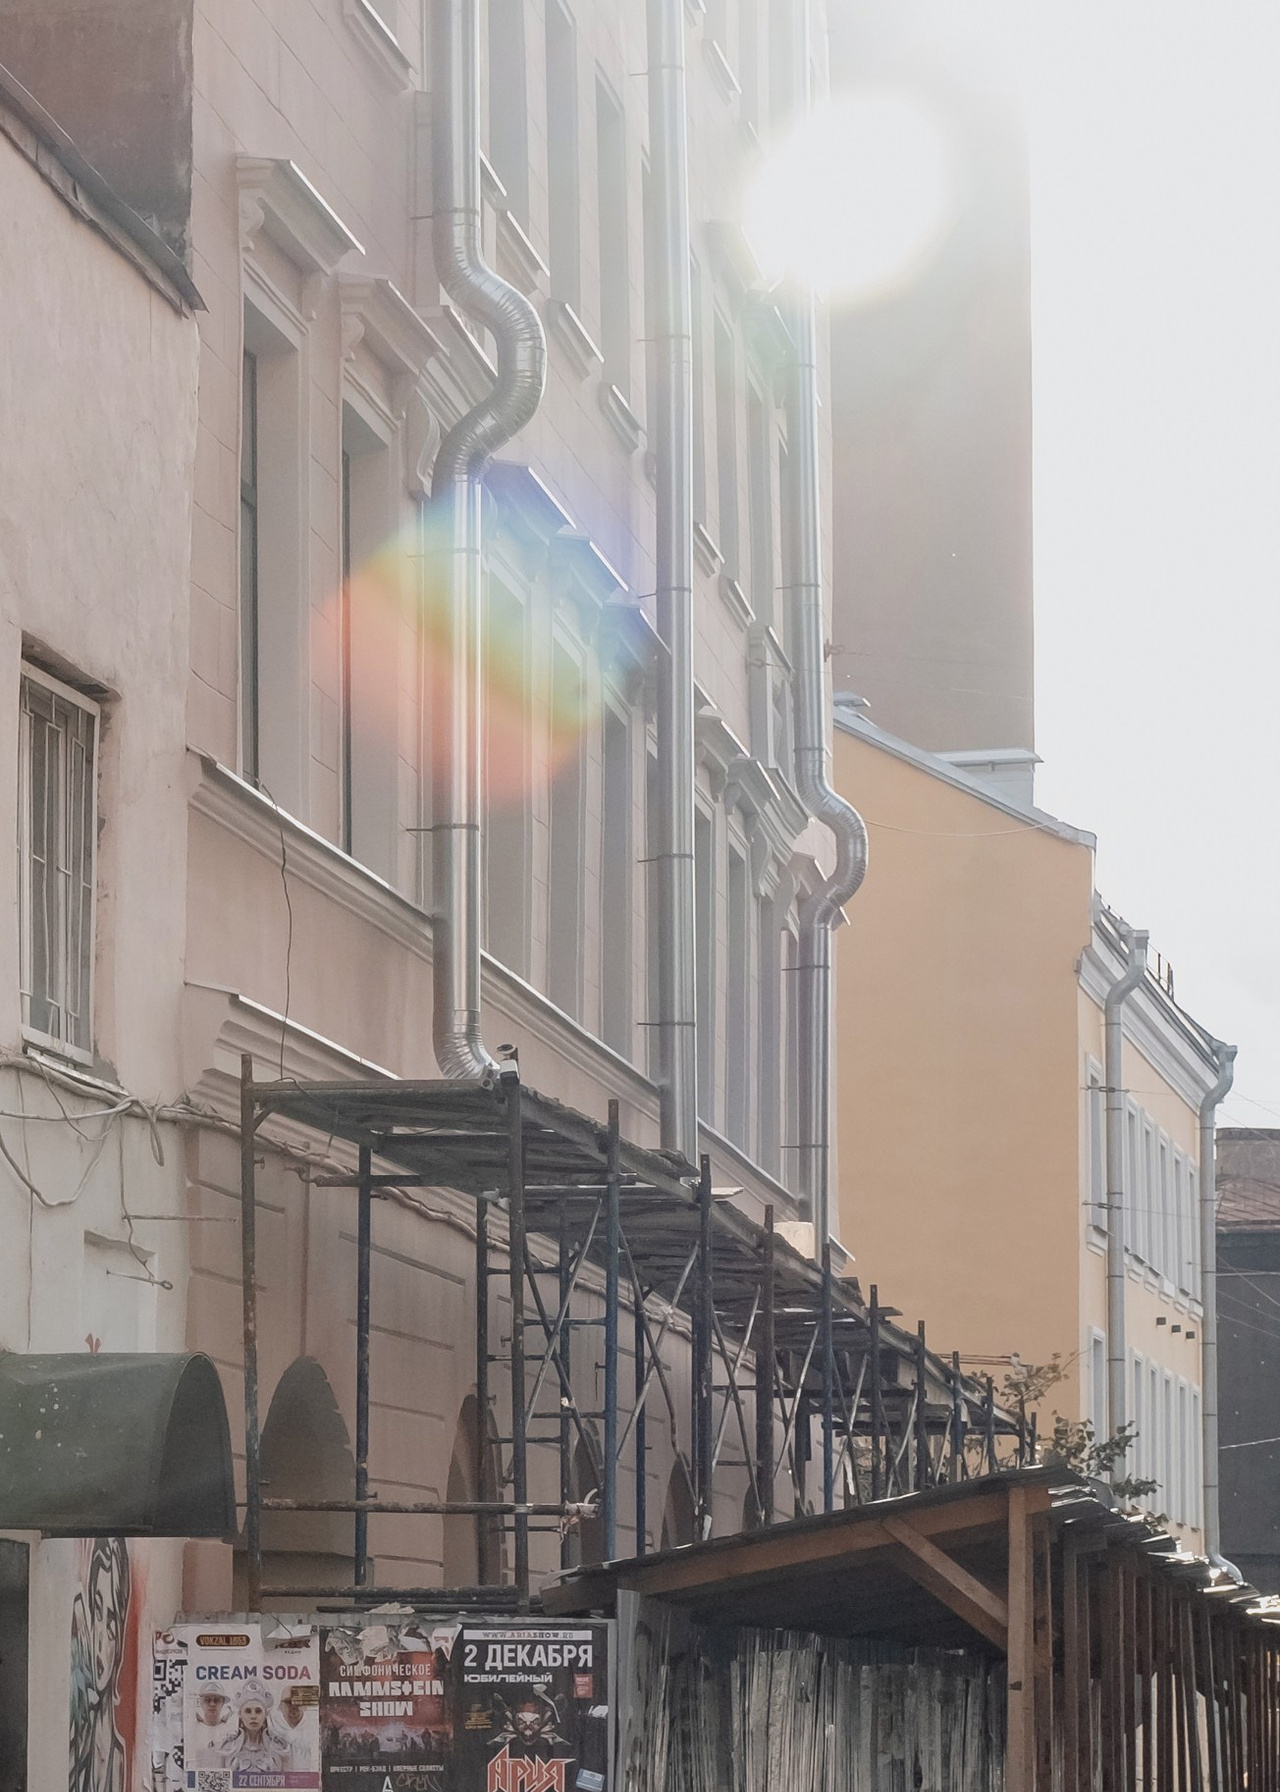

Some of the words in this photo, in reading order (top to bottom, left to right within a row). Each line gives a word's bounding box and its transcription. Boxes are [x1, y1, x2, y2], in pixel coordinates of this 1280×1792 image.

[463, 1644, 478, 1667] 2
[484, 1644, 593, 1671] ДЕКАБРЯ
[195, 1665, 258, 1681] CREAM
[262, 1665, 312, 1681] SODA
[463, 1672, 553, 1683] ЮБИЛЕЙНЫЙ
[238, 1774, 248, 1787] 22
[249, 1774, 286, 1787] СЕНТЯБРЯ
